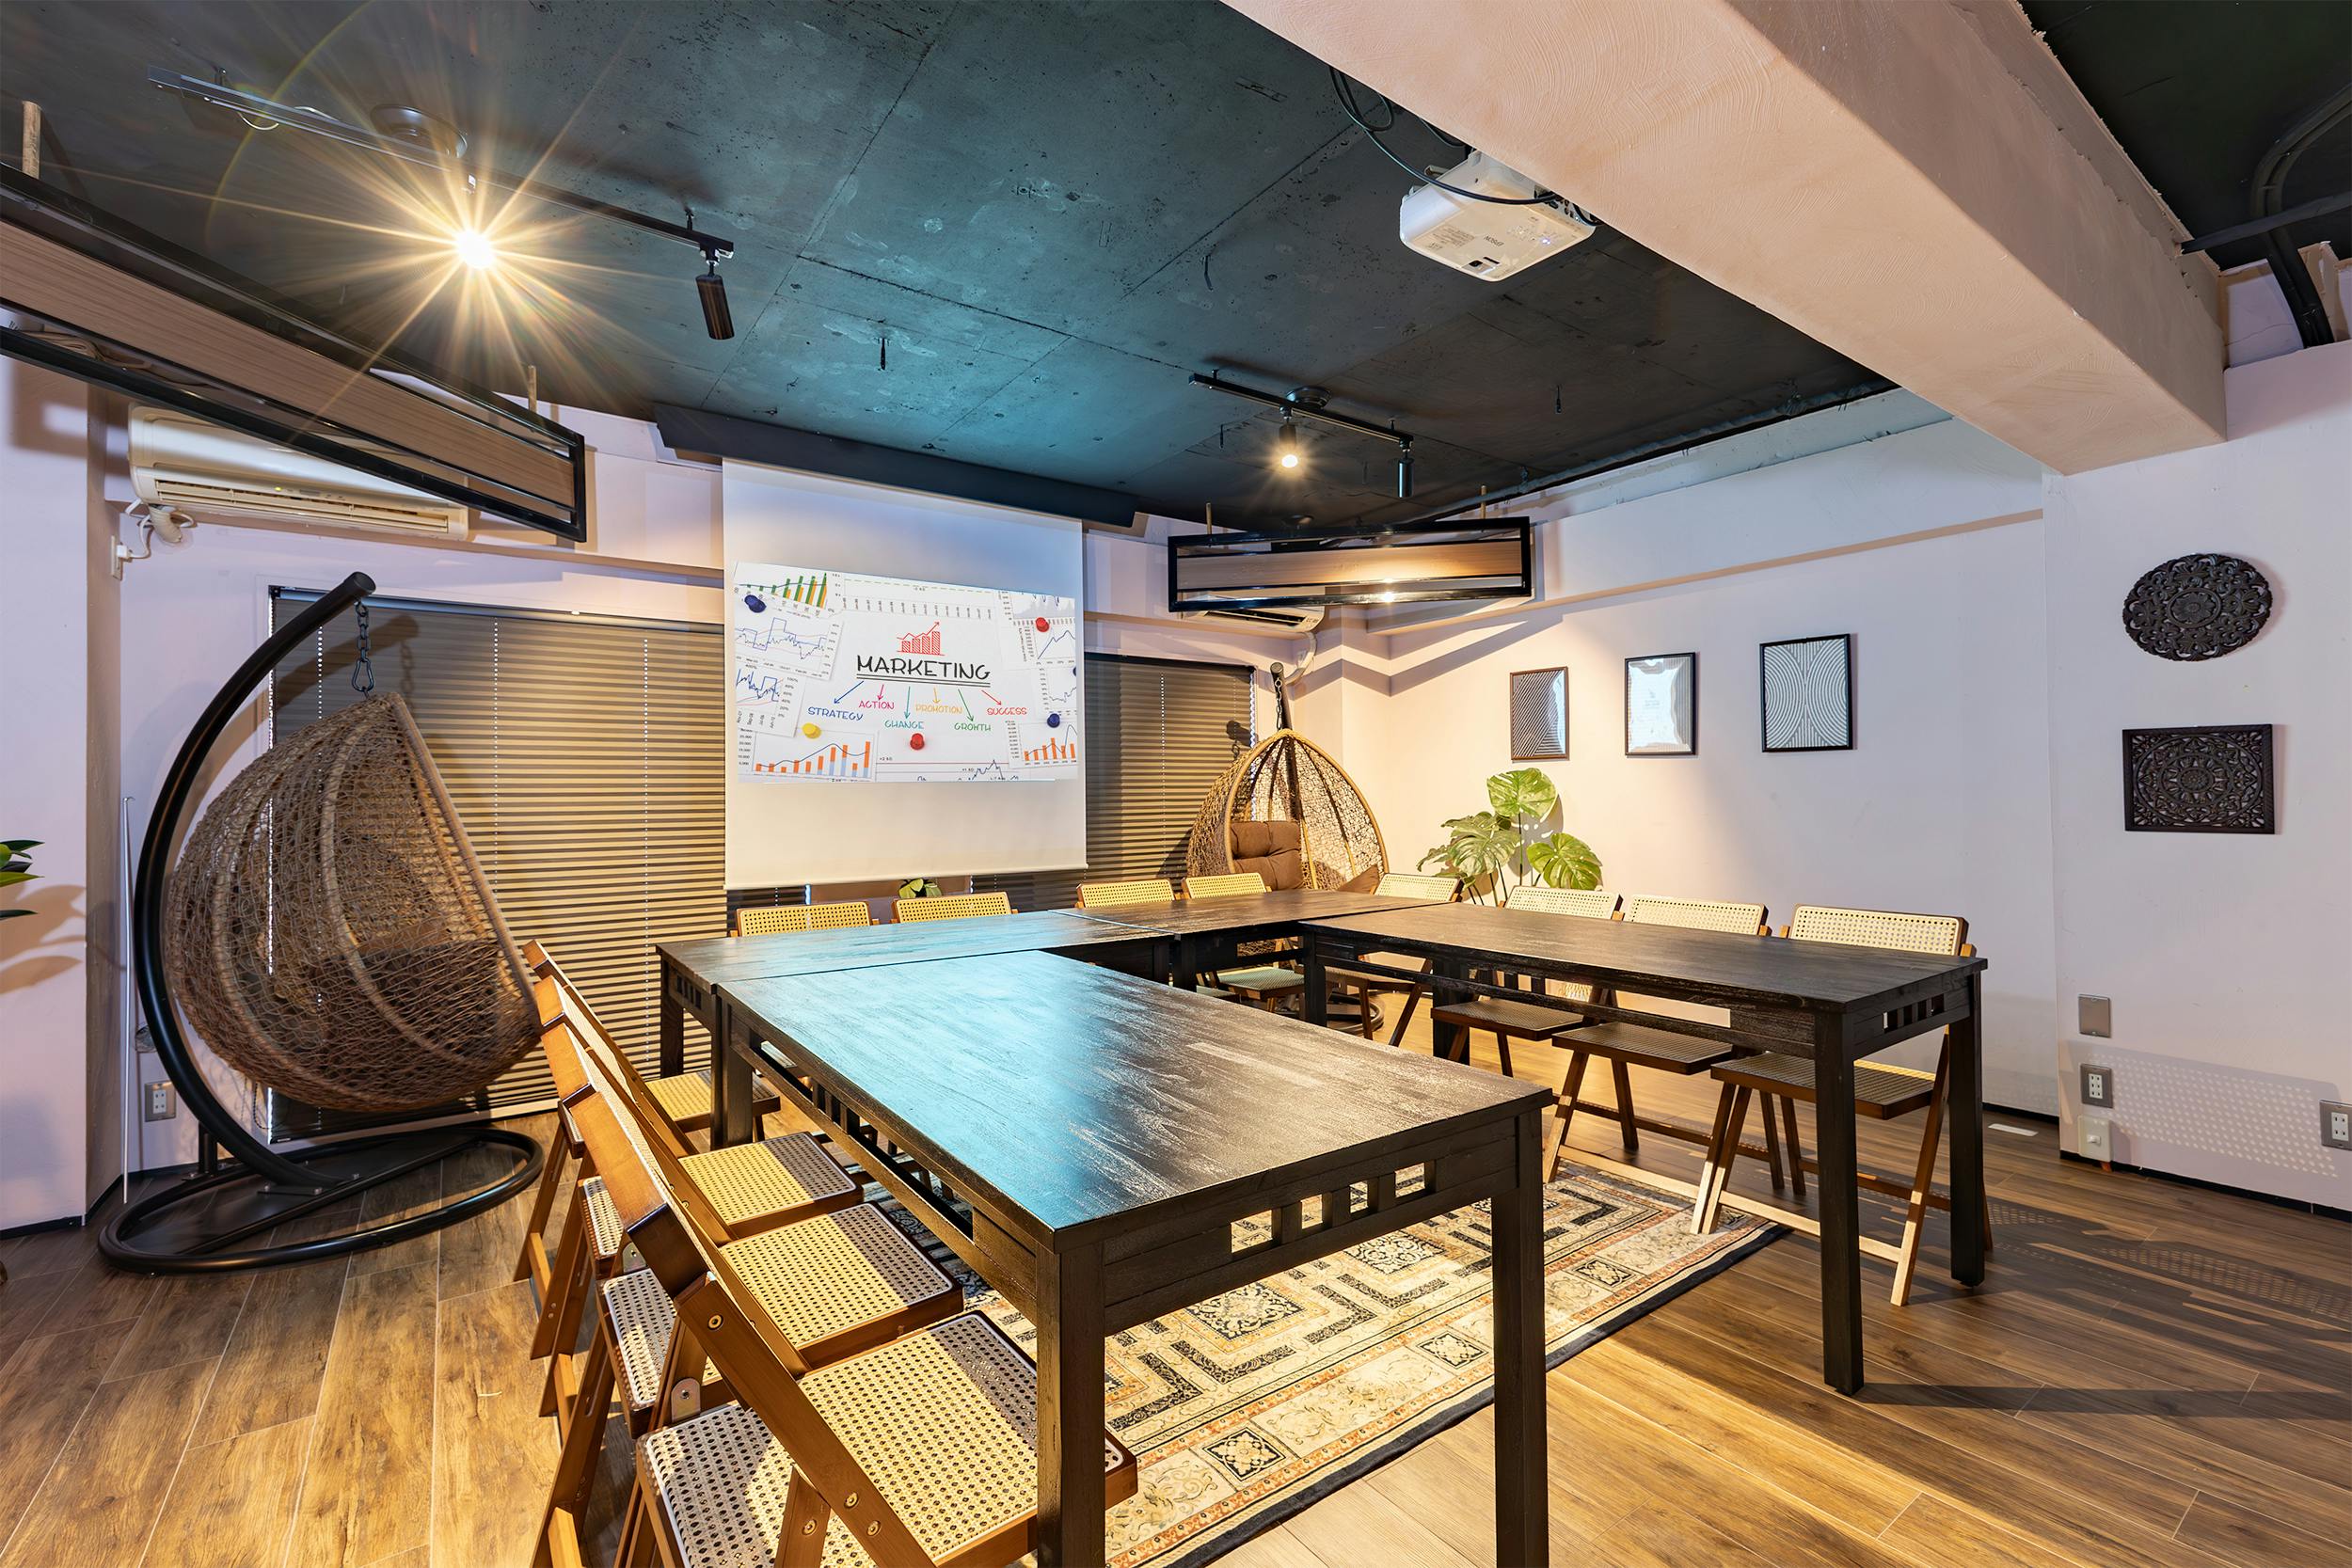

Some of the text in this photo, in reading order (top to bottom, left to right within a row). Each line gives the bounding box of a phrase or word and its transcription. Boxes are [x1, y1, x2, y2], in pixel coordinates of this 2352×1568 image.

[856, 655, 991, 680] MARKETING
[859, 701, 895, 710] ACTION
[915, 705, 963, 714] PROMOTION
[808, 706, 864, 721] STRATEGY
[987, 706, 1027, 716] SUCCESS
[884, 721, 924, 729] CHANGE
[954, 722, 991, 731] GROWTH
